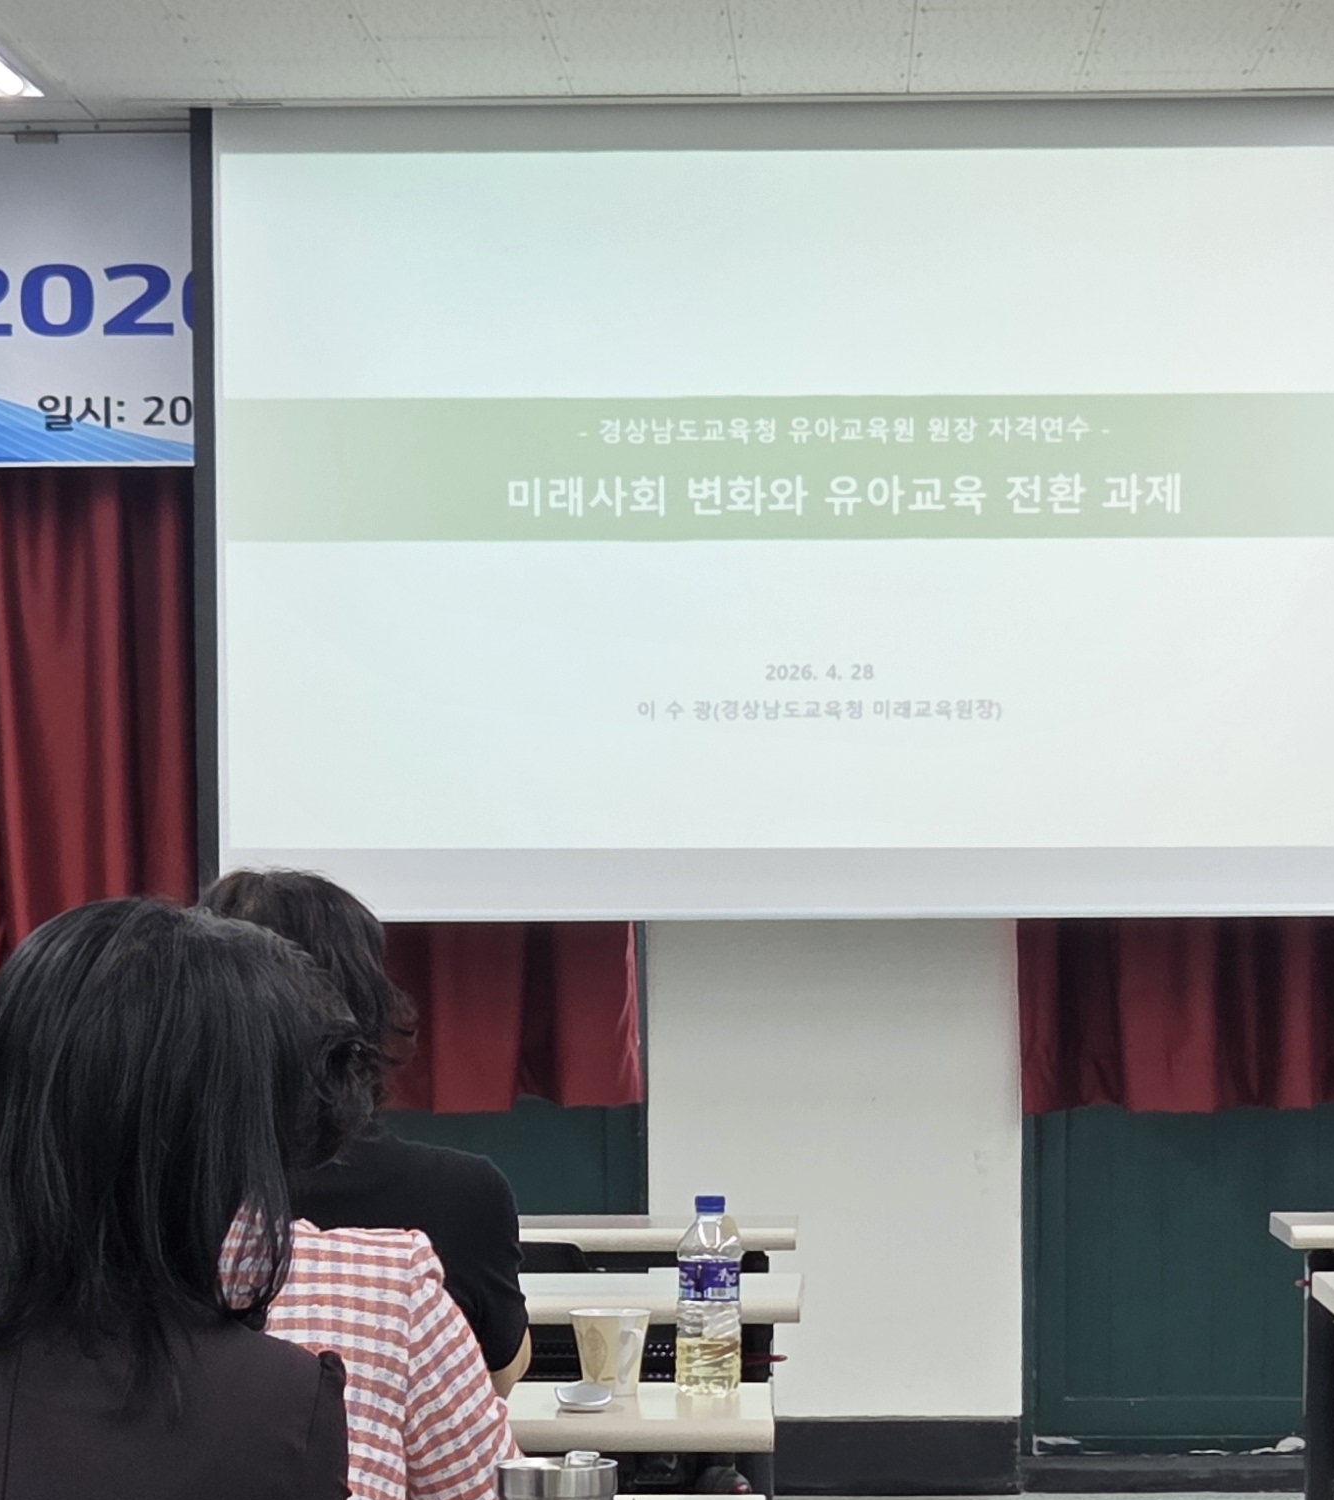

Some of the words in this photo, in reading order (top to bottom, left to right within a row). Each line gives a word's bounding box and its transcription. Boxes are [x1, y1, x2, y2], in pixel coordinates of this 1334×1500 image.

[38, 395, 125, 432] 일시:
[143, 396, 193, 426] 20
[598, 417, 777, 444] 경상남도교육청
[788, 416, 915, 444] 유아교육원
[927, 416, 979, 443] 원장
[988, 415, 1091, 443] 자격연수
[508, 474, 666, 517] 미래사회
[687, 474, 809, 517] 변화와
[824, 474, 987, 516] 유아교육
[1006, 473, 1086, 514] 전환
[1101, 472, 1182, 515] 과제
[765, 663, 819, 682] 2026.
[824, 663, 844, 682] 4.
[849, 663, 876, 682] 28
[637, 699, 656, 721] 이
[664, 699, 685, 721] 수
[872, 698, 1004, 722] 미래교육원장)
